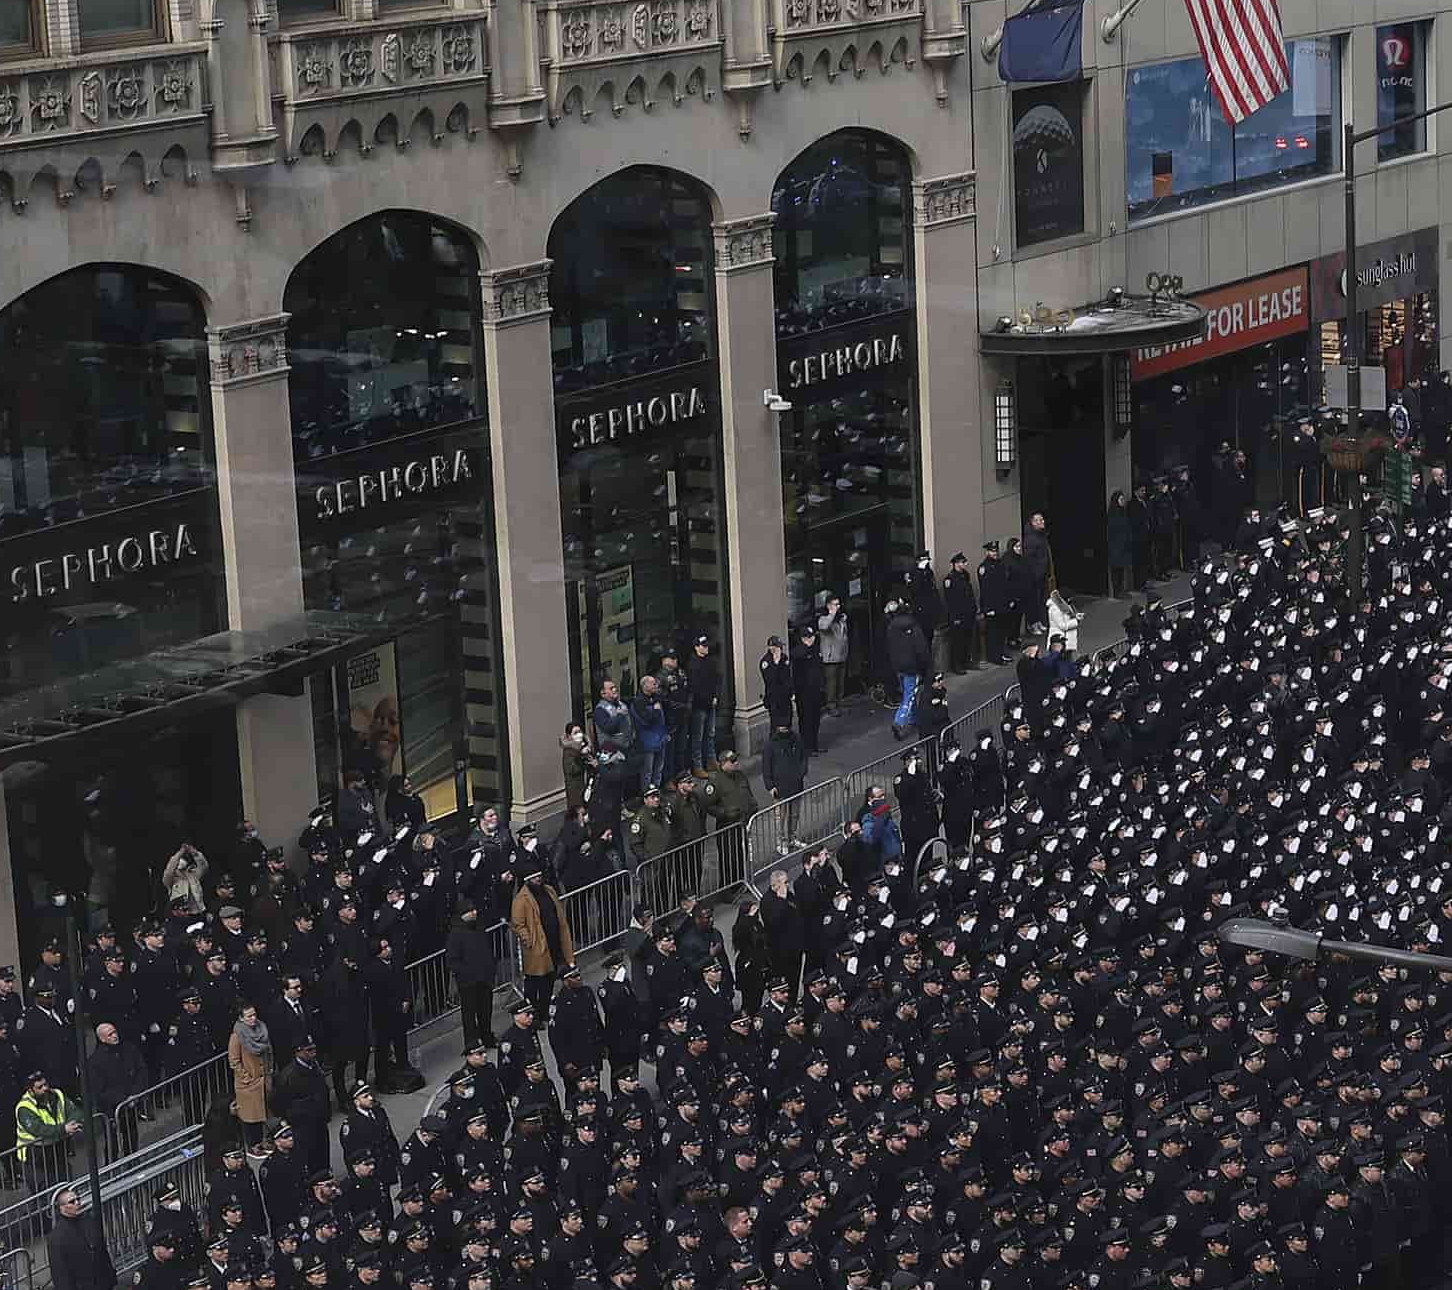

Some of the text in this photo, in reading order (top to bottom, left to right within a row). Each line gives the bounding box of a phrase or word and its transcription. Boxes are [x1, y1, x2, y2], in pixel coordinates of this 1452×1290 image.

[1357, 252, 1417, 287] sunglass hut
[1207, 285, 1302, 341] FOR LEASE
[789, 335, 904, 388] SEPHORA
[571, 388, 706, 448] SEPHORA
[316, 449, 473, 518] SEPHORA
[11, 524, 197, 602] SEPHORA
